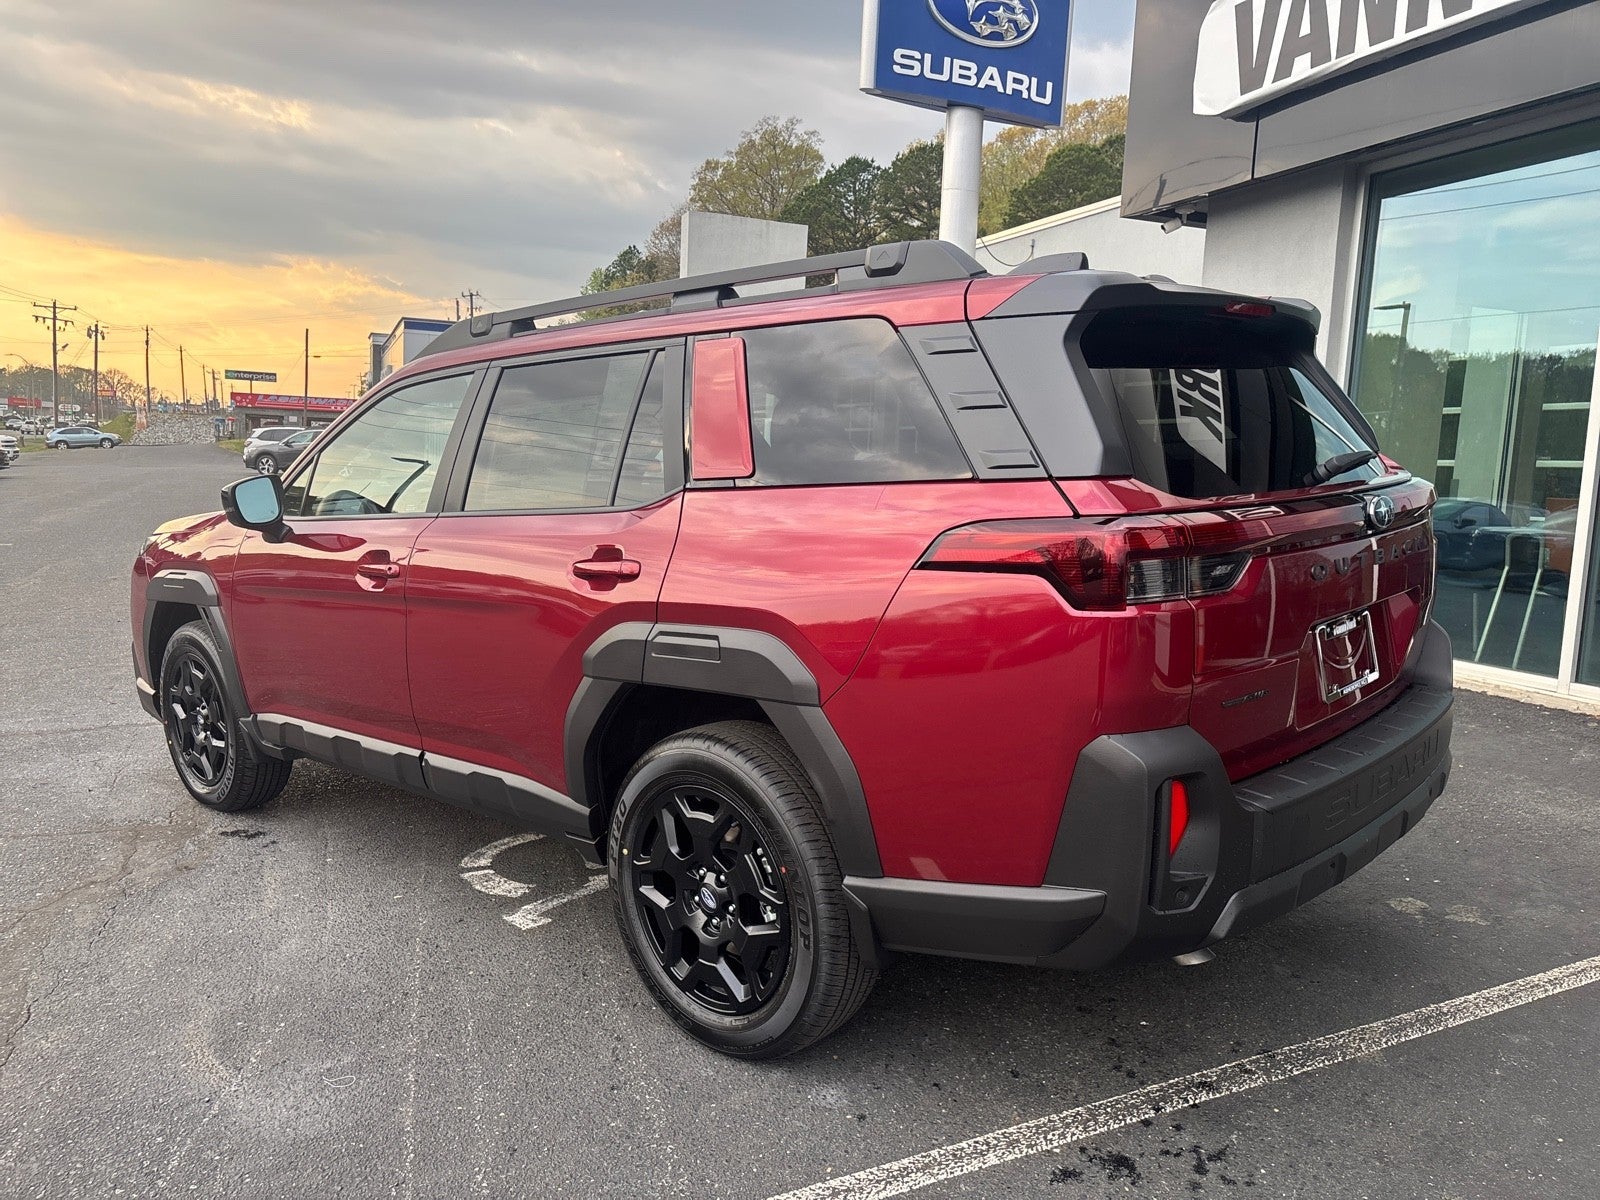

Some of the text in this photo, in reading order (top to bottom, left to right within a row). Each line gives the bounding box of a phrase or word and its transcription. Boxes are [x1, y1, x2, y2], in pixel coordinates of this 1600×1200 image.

[891, 47, 1054, 106] SUBARU
[226, 371, 276, 380] enterprise
[1310, 536, 1428, 582] OUTBACK
[1323, 729, 1440, 832] SUBARU
